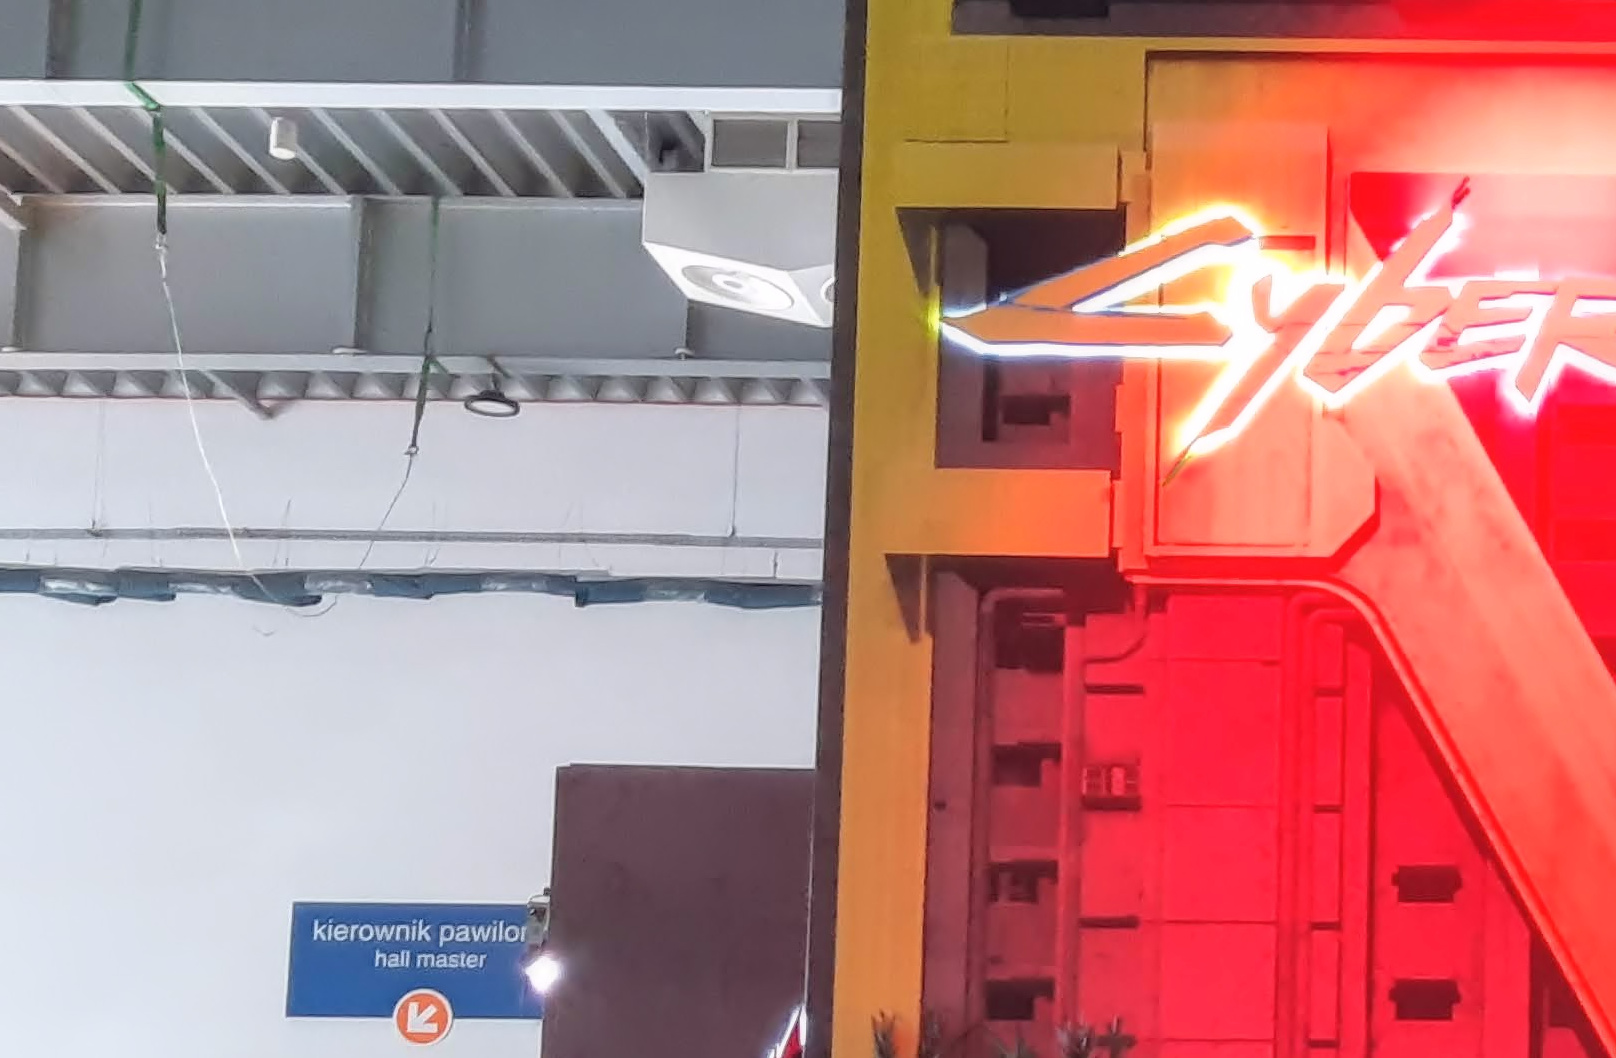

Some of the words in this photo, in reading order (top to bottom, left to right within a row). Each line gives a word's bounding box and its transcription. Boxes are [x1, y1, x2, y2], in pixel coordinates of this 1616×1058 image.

[313, 919, 431, 943] kierownik
[374, 949, 410, 968] hall
[416, 953, 487, 969] master
